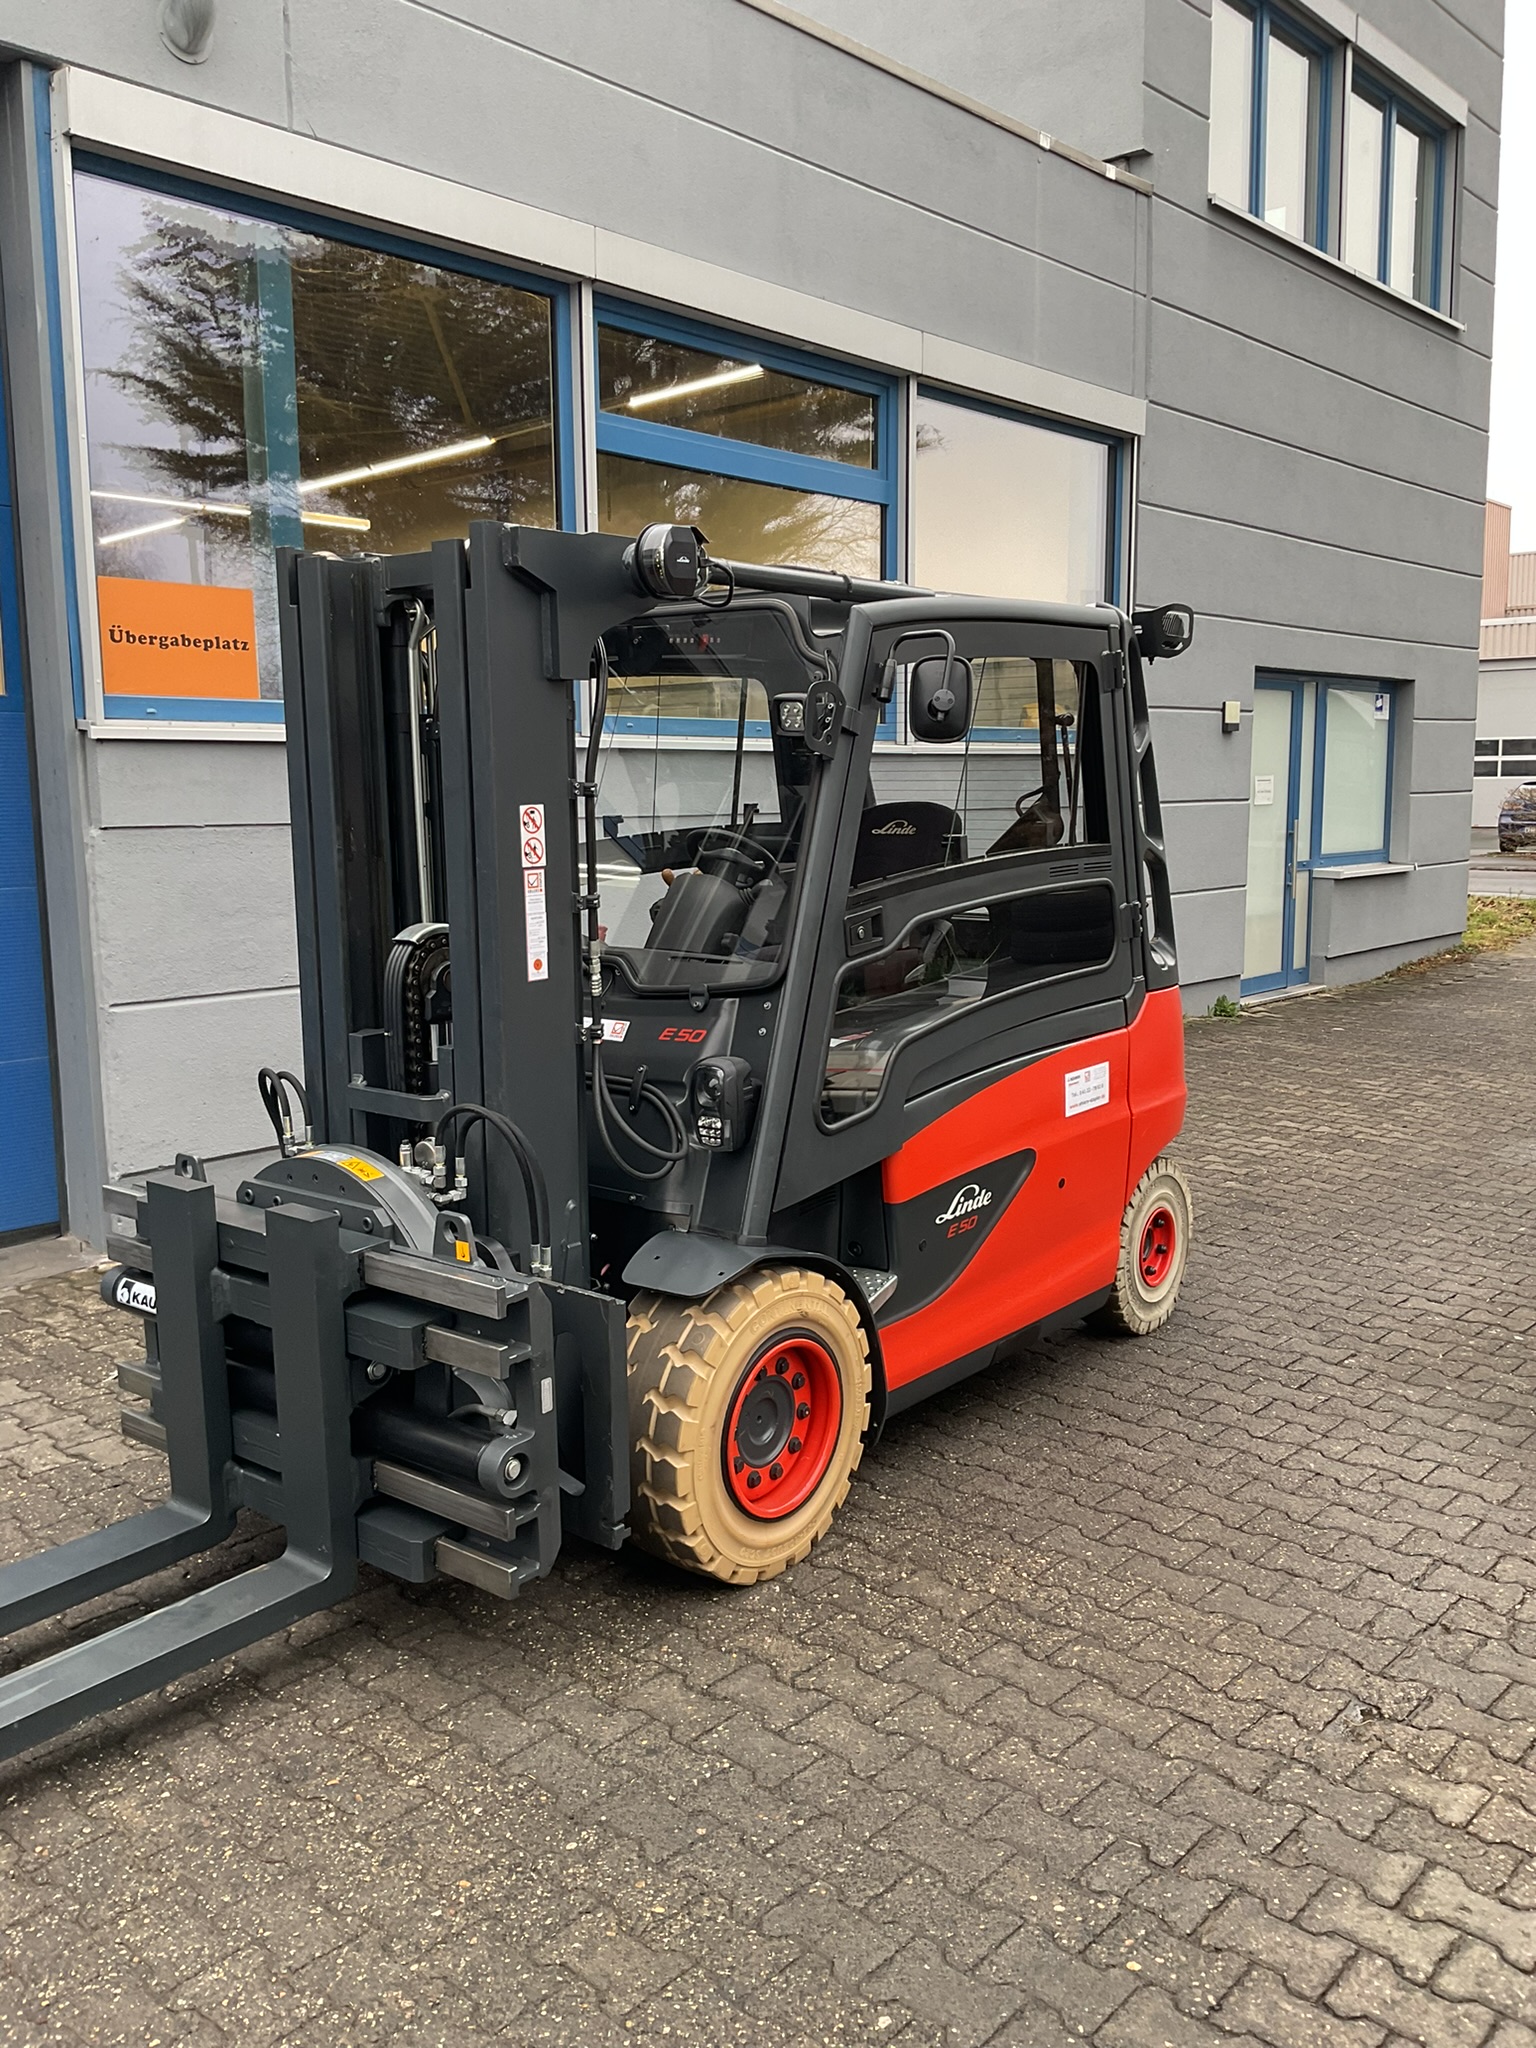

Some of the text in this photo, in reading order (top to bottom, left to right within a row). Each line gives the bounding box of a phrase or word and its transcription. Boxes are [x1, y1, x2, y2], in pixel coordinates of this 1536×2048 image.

[108, 624, 250, 651] Übergabeplatz
[872, 819, 916, 835] Linde
[935, 1184, 993, 1224] Linde
